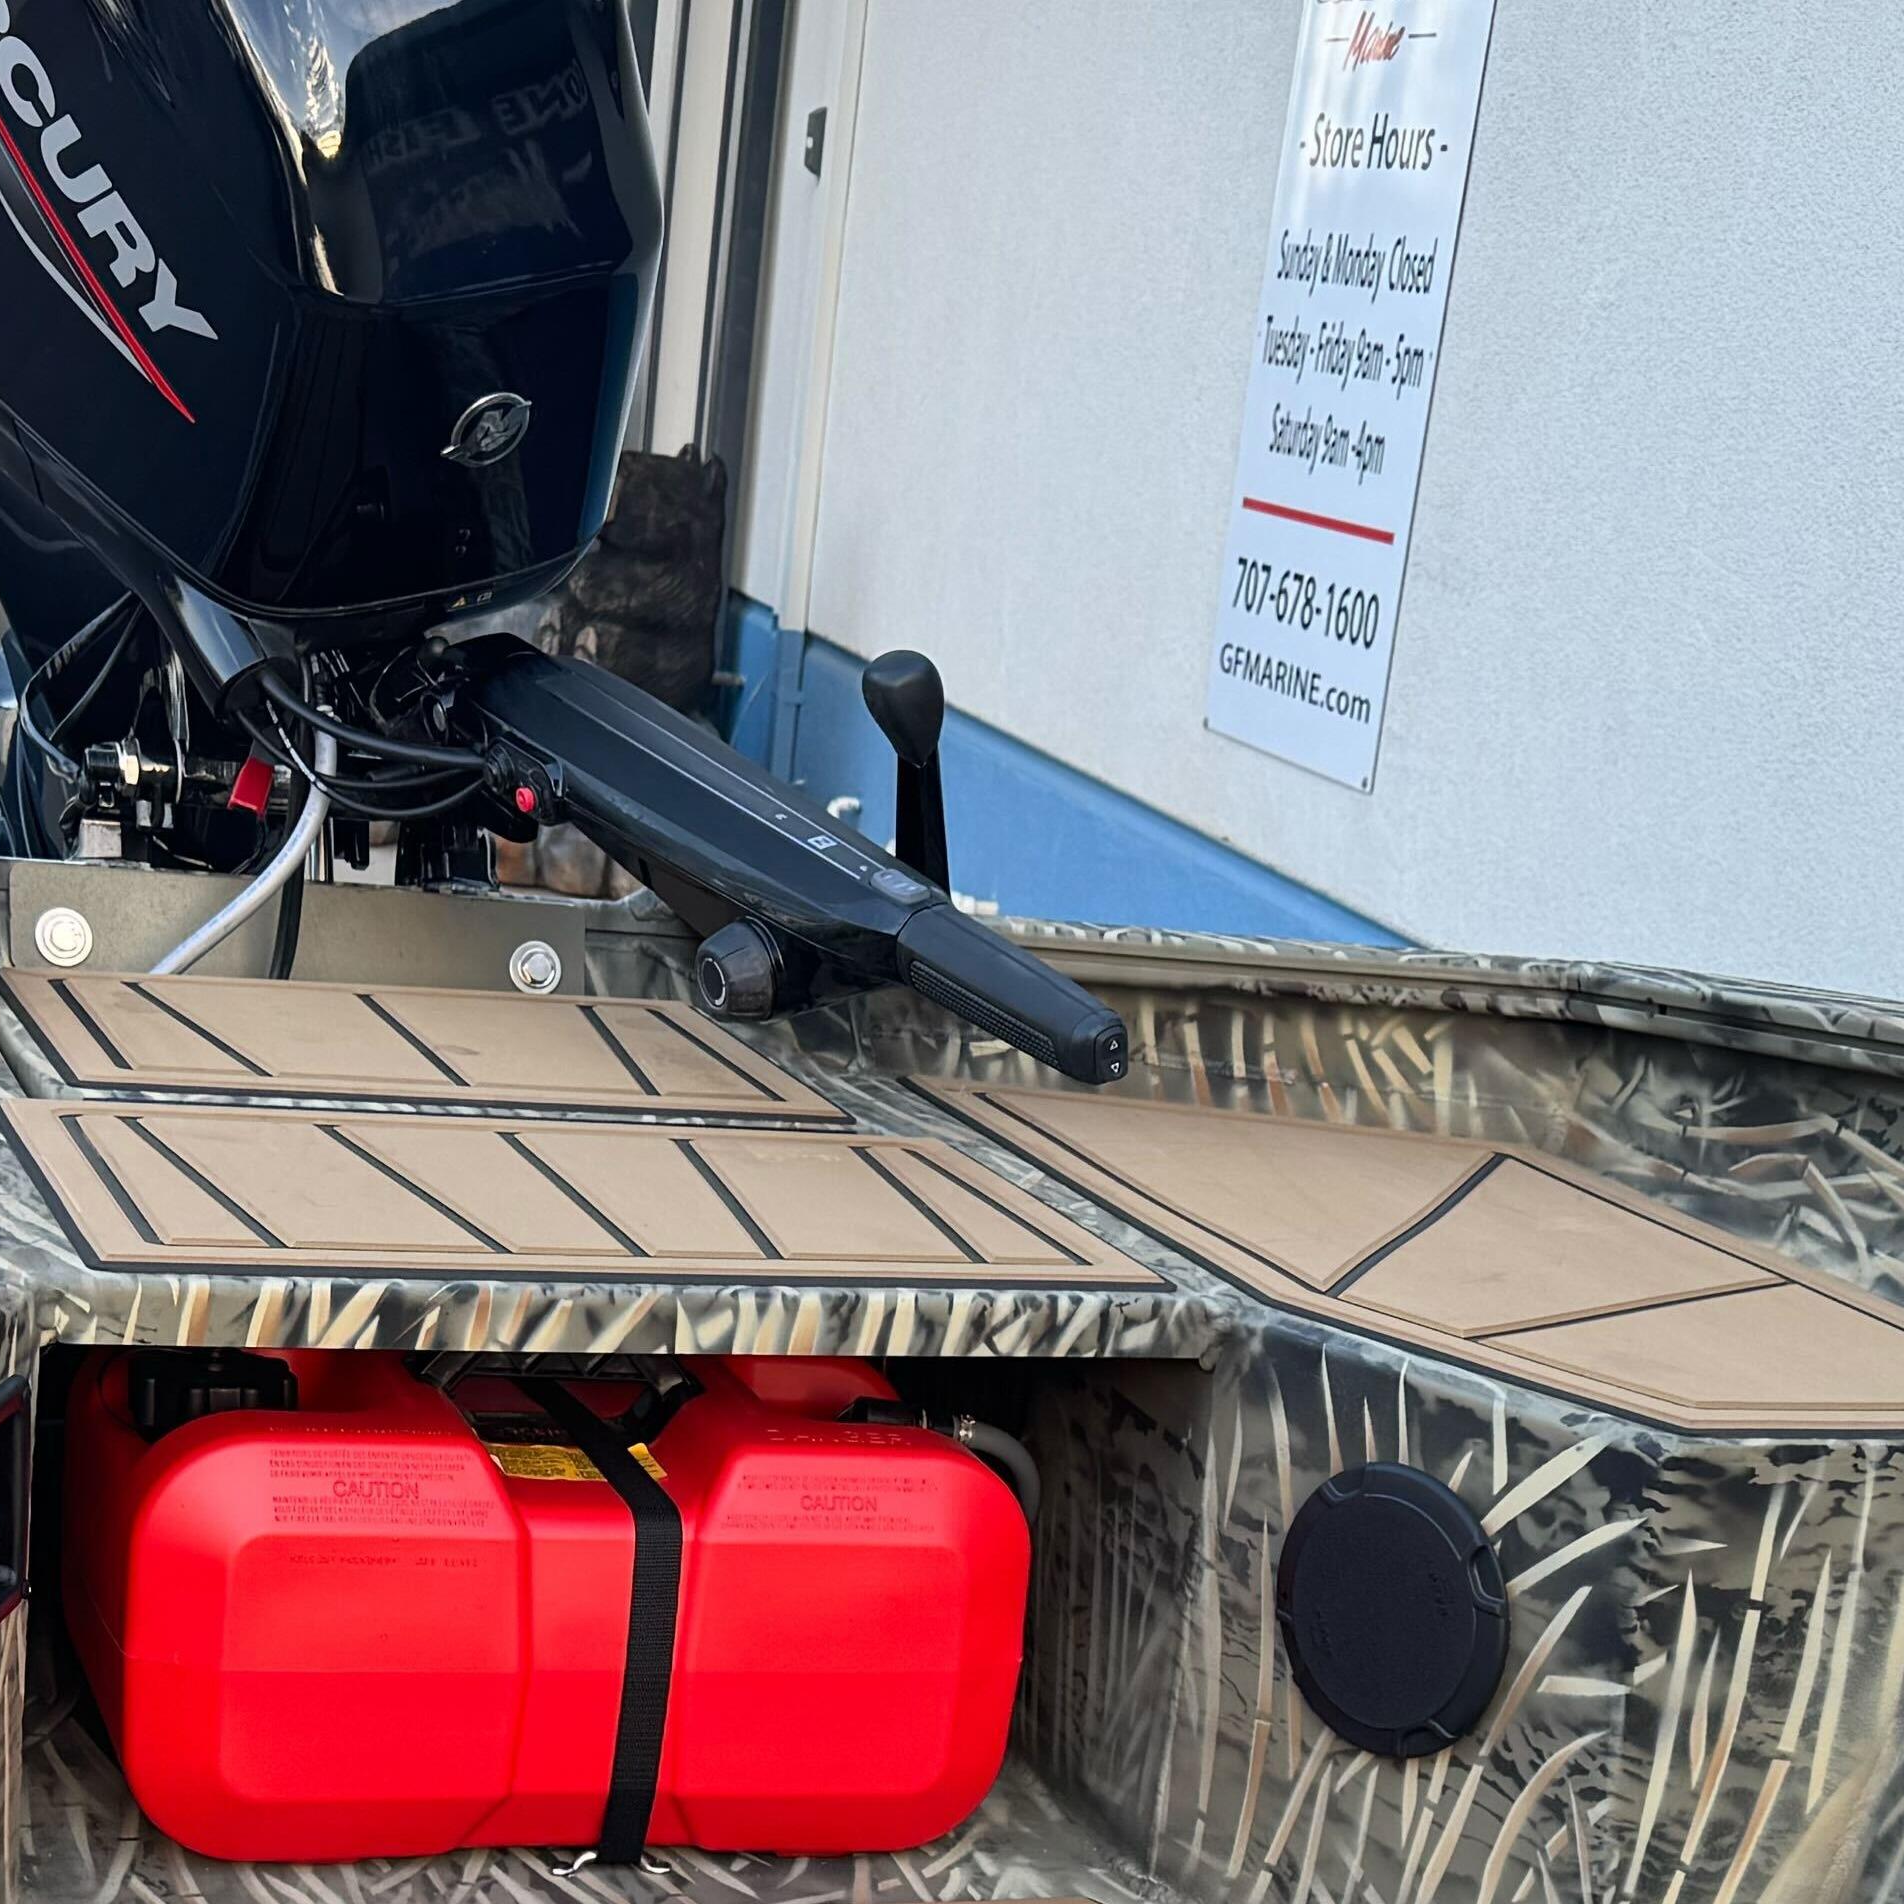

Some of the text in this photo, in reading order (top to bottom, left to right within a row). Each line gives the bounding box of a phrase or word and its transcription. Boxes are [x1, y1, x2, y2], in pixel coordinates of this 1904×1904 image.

[1309, 112, 1364, 169] Store
[1367, 112, 1435, 171] Hours
[1277, 228, 1438, 304] Sunday & Monday Closed
[1262, 314, 1311, 384] Tuesday
[1314, 320, 1356, 392] Friday
[1354, 328, 1384, 381] 9am
[1391, 333, 1424, 400] 5pm
[1269, 402, 1323, 475] Saturday
[1320, 413, 1350, 468] 9am
[1232, 557, 1380, 649] 707-678-1600
[1219, 642, 1371, 724] GFMARINE.com
[332, 1480, 419, 1500] CAUTION
[799, 1495, 878, 1512] CAUTION
